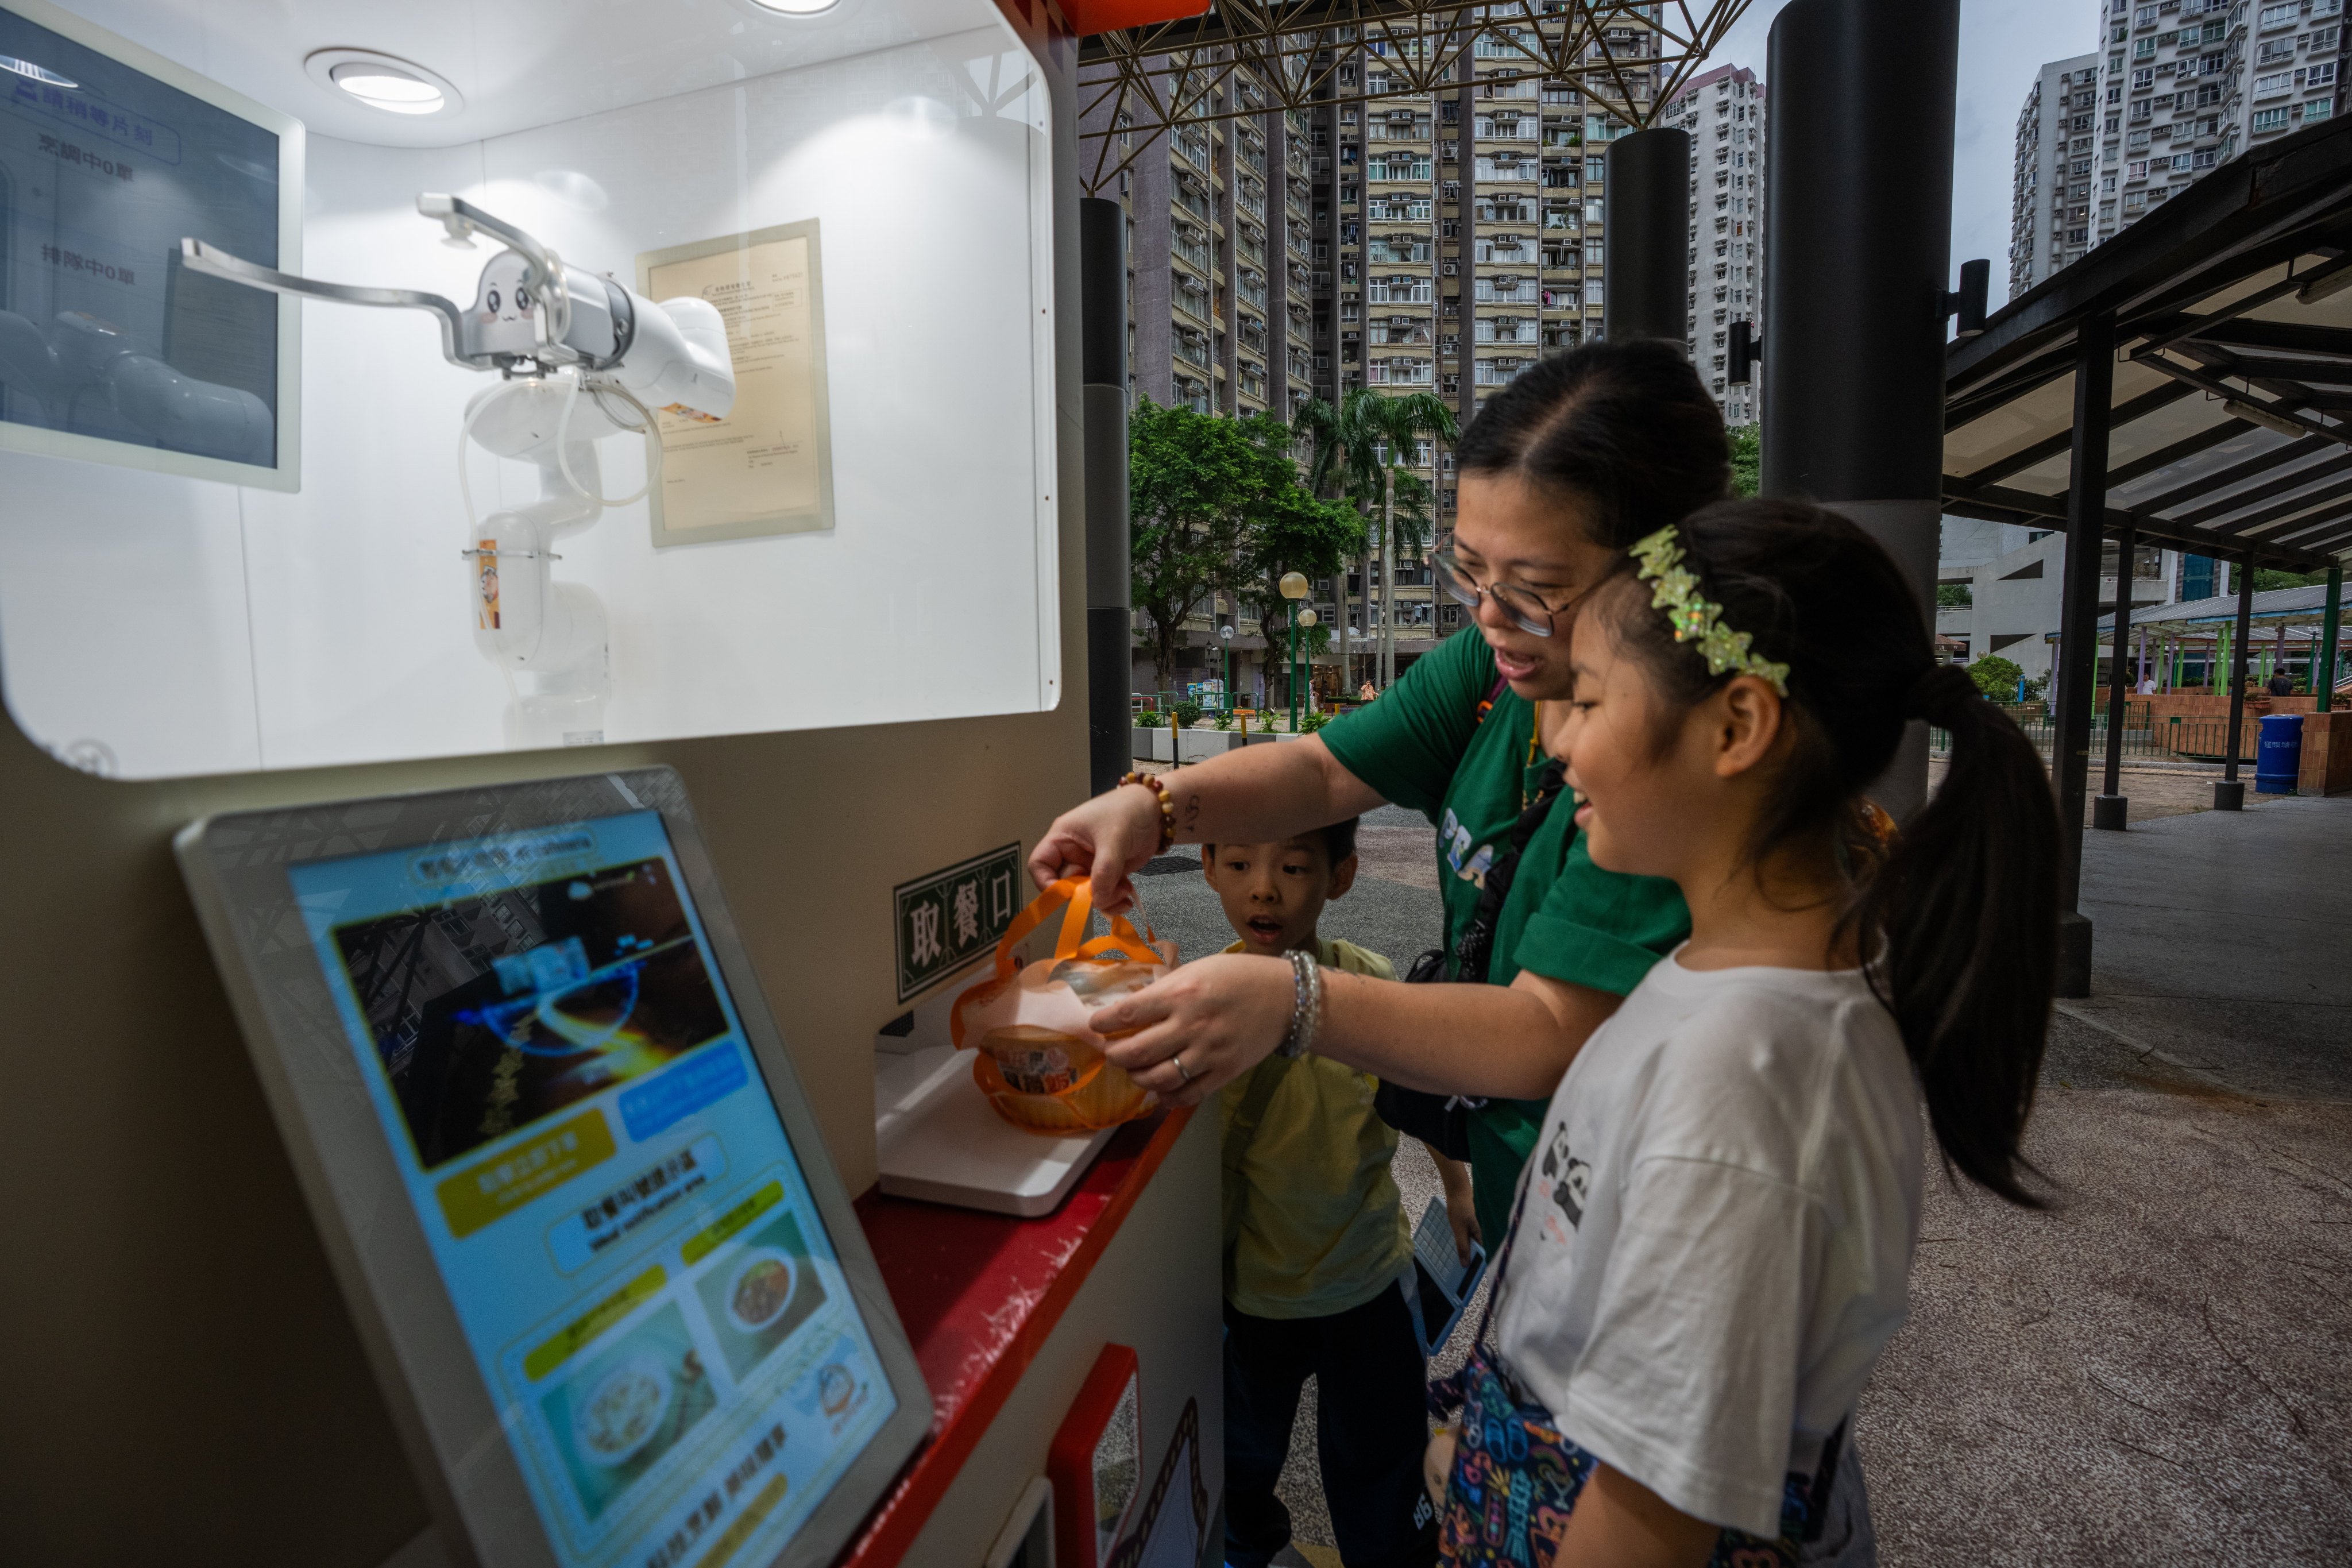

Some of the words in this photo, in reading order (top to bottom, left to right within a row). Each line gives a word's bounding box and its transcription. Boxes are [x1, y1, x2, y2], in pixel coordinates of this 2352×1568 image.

[41, 243, 136, 285] 排隊中0單
[910, 870, 1011, 968] 取餐口
